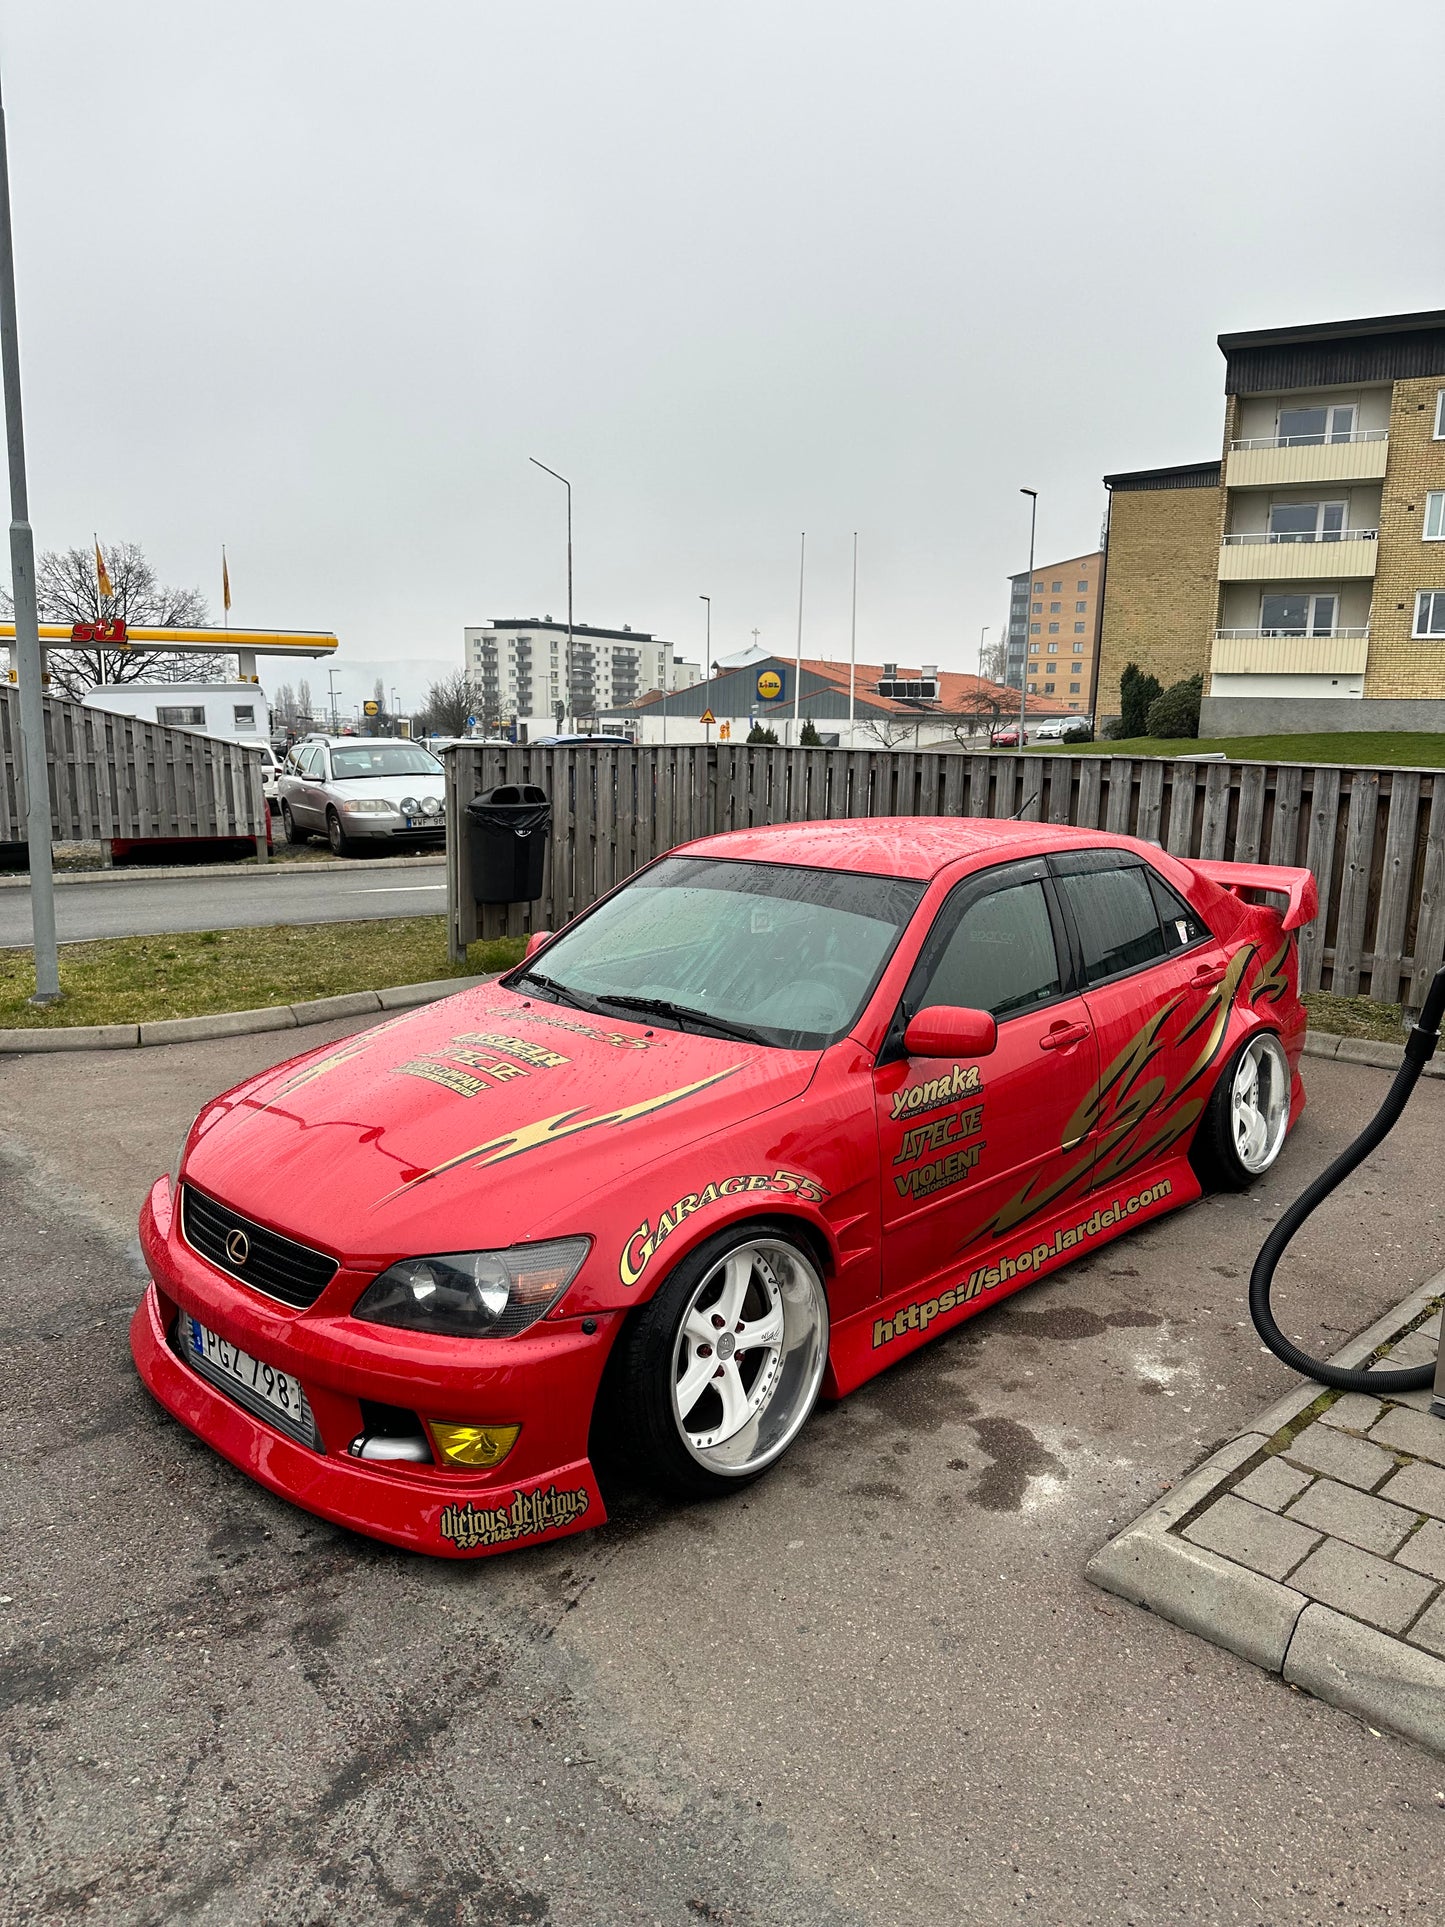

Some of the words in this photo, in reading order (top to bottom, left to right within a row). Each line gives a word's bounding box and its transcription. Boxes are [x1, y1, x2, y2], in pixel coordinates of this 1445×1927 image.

[412, 818, 427, 826] WWF
[433, 817, 446, 826] 96
[890, 1064, 980, 1120] yonaka
[894, 1146, 982, 1197] VIOLENT
[913, 1170, 969, 1199] MOTORSPORT
[872, 1178, 1172, 1350] https://shop.lardel.com
[206, 1329, 243, 1378] PGZ
[248, 1356, 290, 1408] 798
